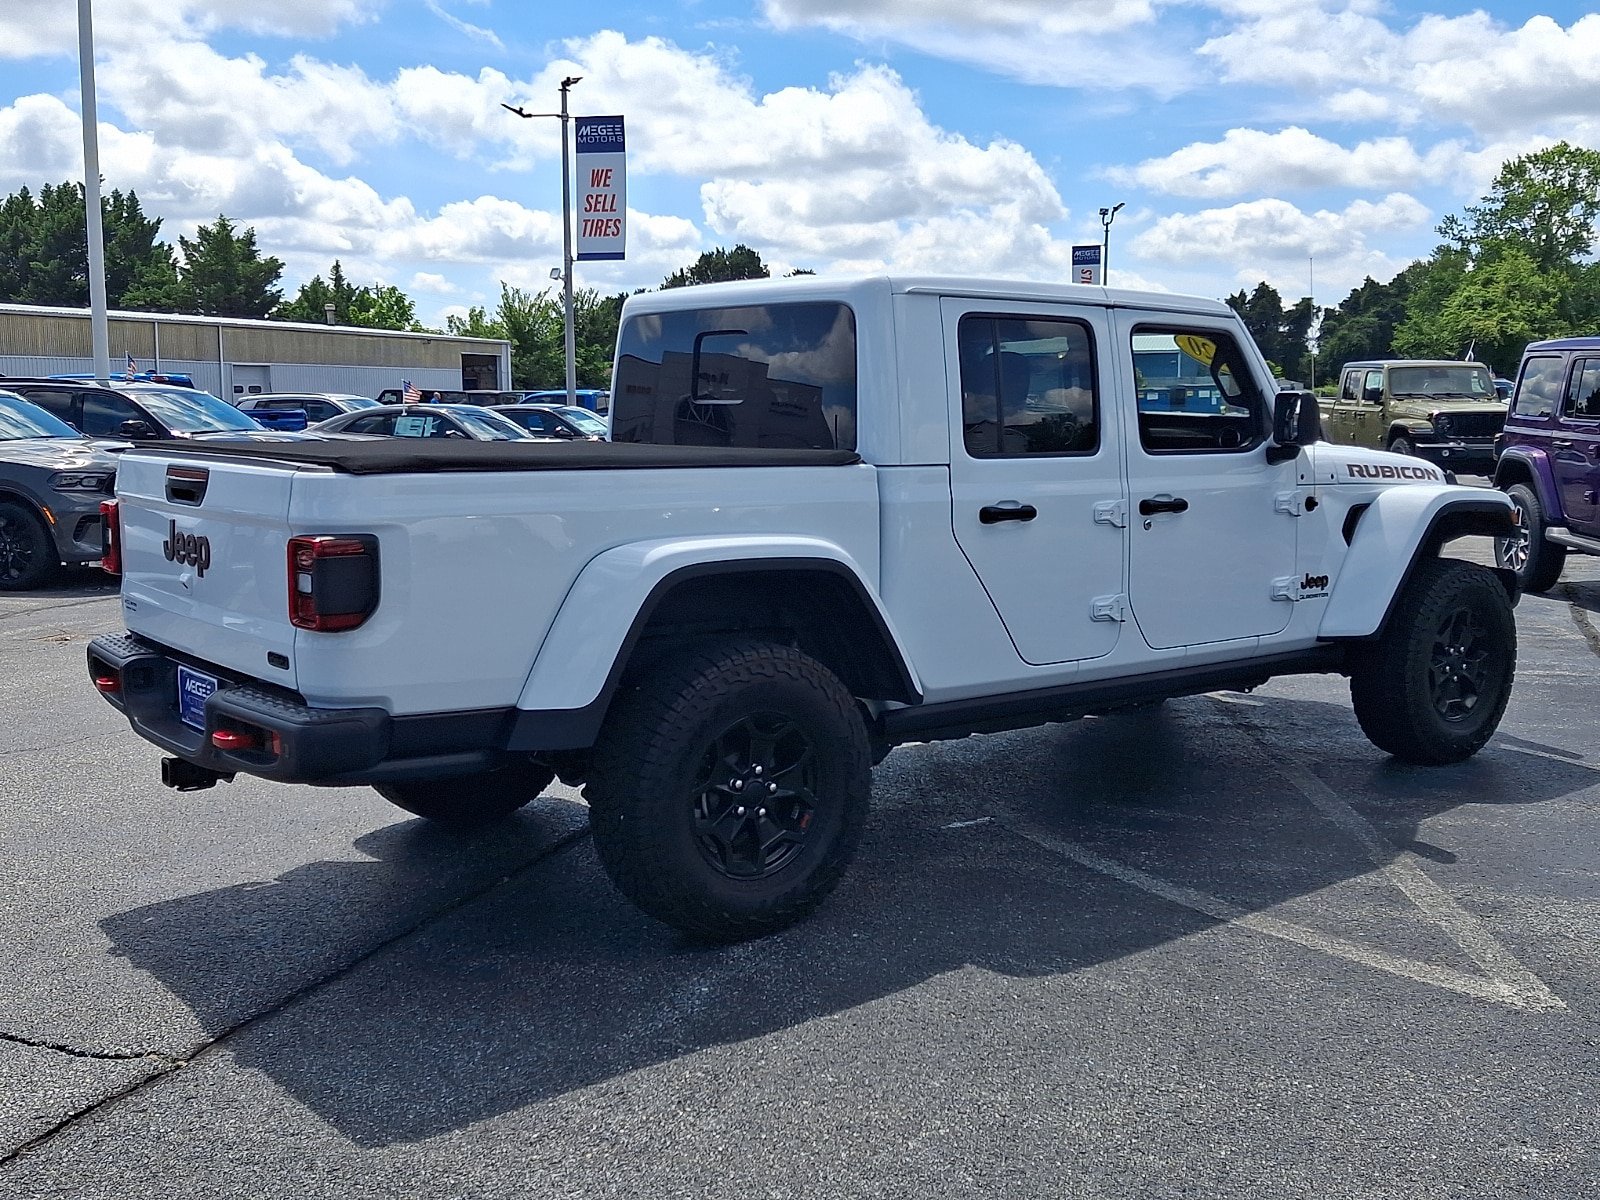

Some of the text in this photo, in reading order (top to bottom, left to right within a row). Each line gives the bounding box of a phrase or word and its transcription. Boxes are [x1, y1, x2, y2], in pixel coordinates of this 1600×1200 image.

[577, 135, 624, 143] MOTORS
[578, 124, 622, 136] MEGEE
[590, 168, 613, 187] WE
[584, 194, 617, 213] SELL
[582, 218, 621, 237] TIRES
[1346, 464, 1439, 481] RUBICON
[163, 519, 211, 578] Jeep
[1300, 572, 1329, 591] Jeep
